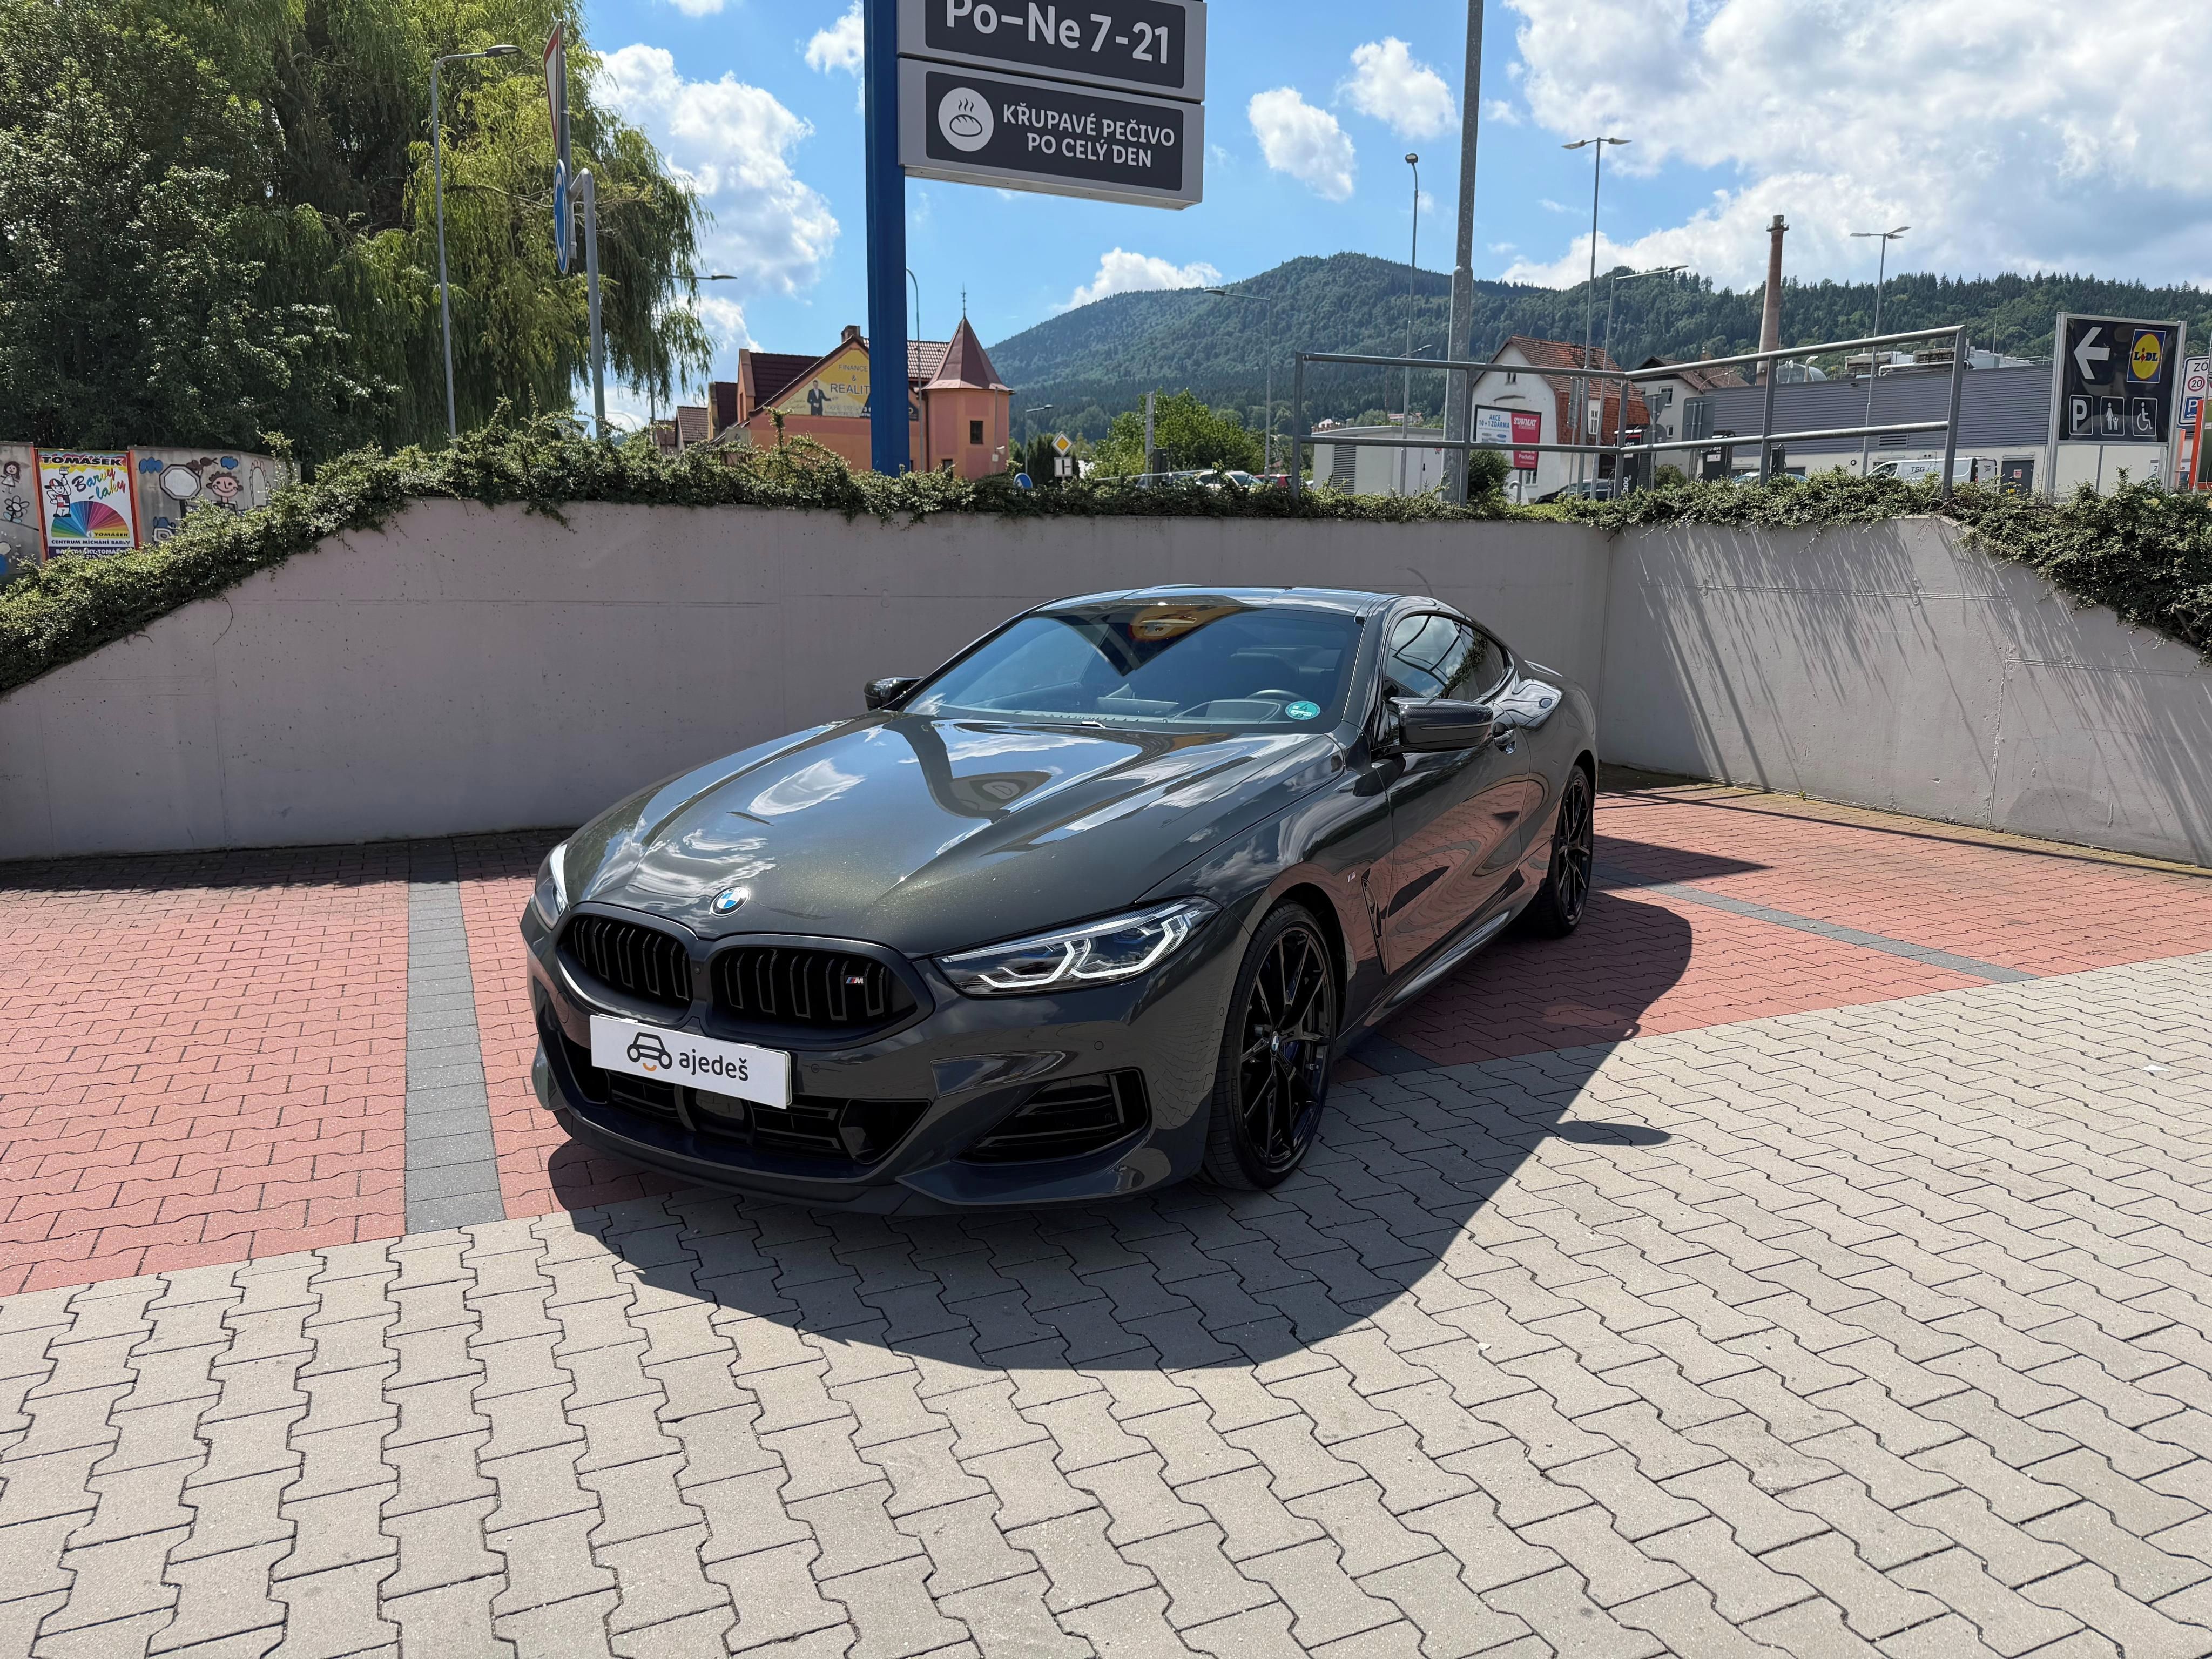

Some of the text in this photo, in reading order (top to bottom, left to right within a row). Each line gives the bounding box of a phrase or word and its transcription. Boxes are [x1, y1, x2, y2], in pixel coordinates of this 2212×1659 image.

[1090, 13, 1168, 64] 7-21
[1003, 102, 1175, 147] KŘUPAVÉ PEČIVO
[1027, 133, 1151, 167] PO CELÝ DEN
[839, 364, 868, 372] FINANCE
[2193, 360, 2208, 372] ZÓ
[831, 383, 870, 395] REALIT
[2191, 380, 2202, 388] 20
[1513, 417, 1537, 427] STAVMAT
[42, 456, 122, 466] TOMÁŠEK
[679, 1049, 749, 1081] ajedeš
